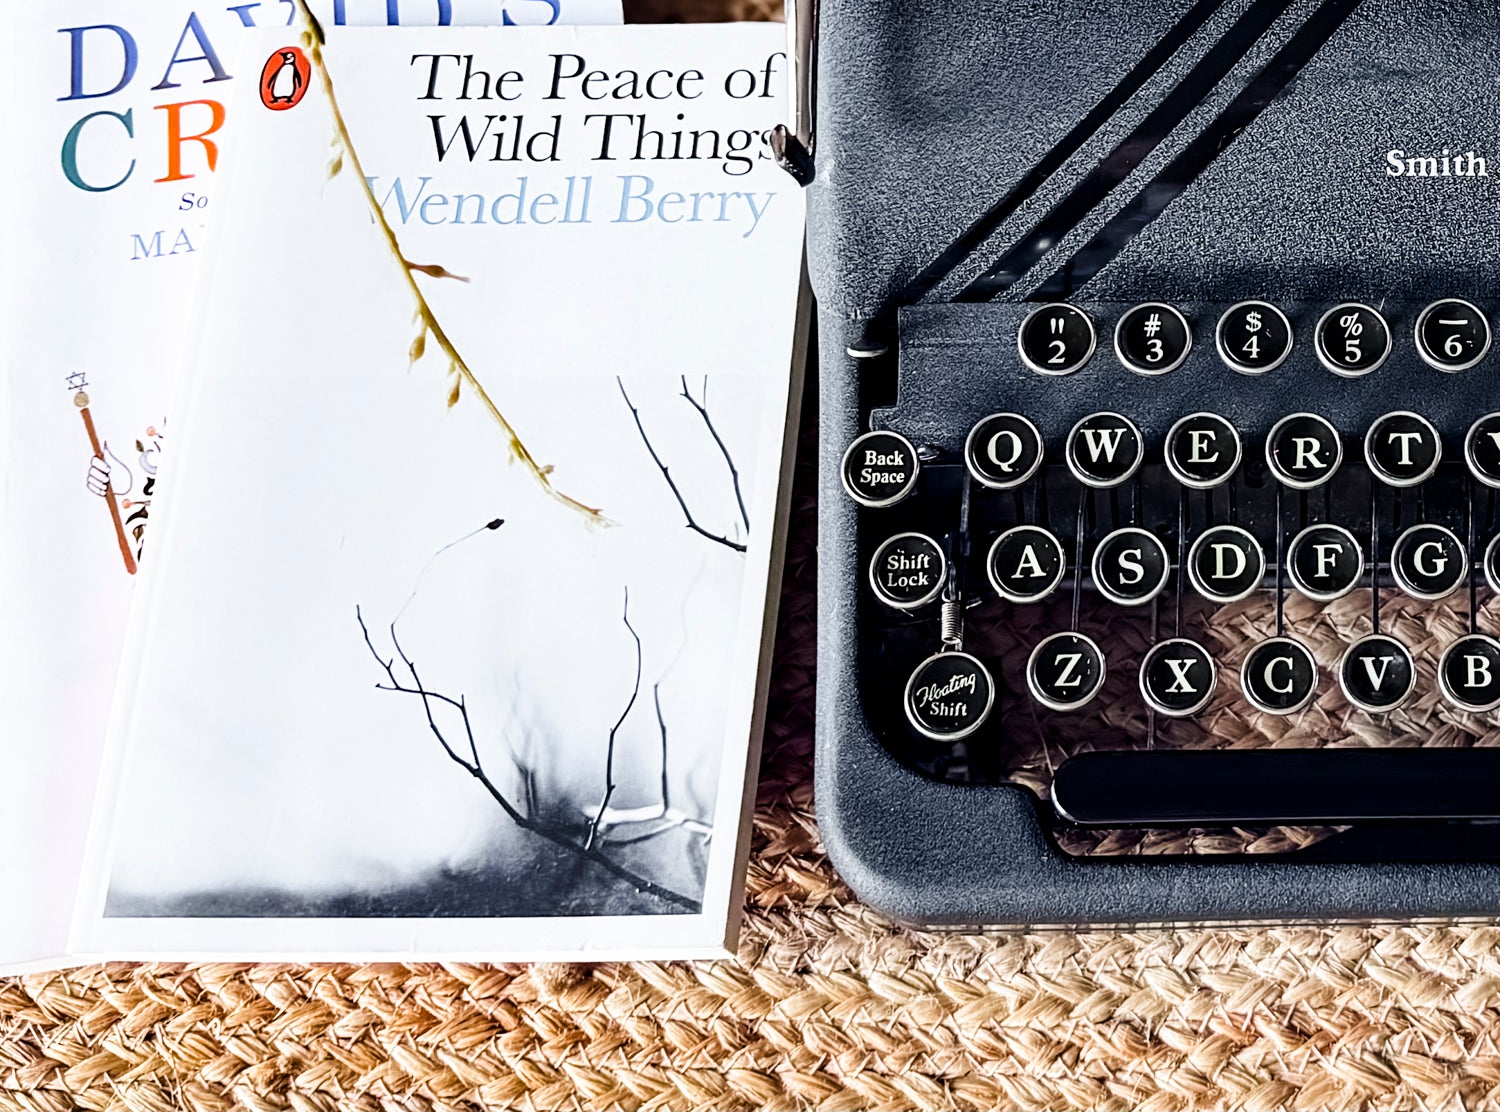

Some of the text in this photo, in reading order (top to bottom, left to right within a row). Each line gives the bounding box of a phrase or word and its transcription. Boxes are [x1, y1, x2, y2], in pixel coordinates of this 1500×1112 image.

[411, 52, 787, 101] The Peace of
[432, 114, 560, 163] Wild
[1386, 148, 1489, 177] Smith
[365, 174, 777, 239] Wendell Berry
[1048, 341, 1065, 363] 2
[1146, 339, 1163, 362] 3
[1243, 336, 1260, 358] 4
[1345, 339, 1361, 362] 5
[1445, 335, 1462, 356] 6
[865, 451, 903, 465] Back
[985, 431, 1022, 474] Q
[1078, 426, 1127, 465] W
[1188, 431, 1218, 462] E
[1292, 438, 1329, 468] R
[1389, 433, 1422, 464] T
[860, 469, 904, 486] Space
[888, 554, 930, 569] Shift
[1011, 544, 1047, 578] A
[1119, 549, 1144, 584] S
[1211, 544, 1246, 578] D
[1313, 544, 1343, 577] F
[1414, 542, 1448, 576] G
[888, 572, 928, 586] Lock
[1055, 654, 1082, 686] Z
[1165, 659, 1197, 692] X
[1264, 657, 1293, 693] C
[1360, 656, 1395, 690] V
[1464, 655, 1491, 687] B
[916, 672, 975, 707] Floating
[930, 702, 967, 716] Shift
